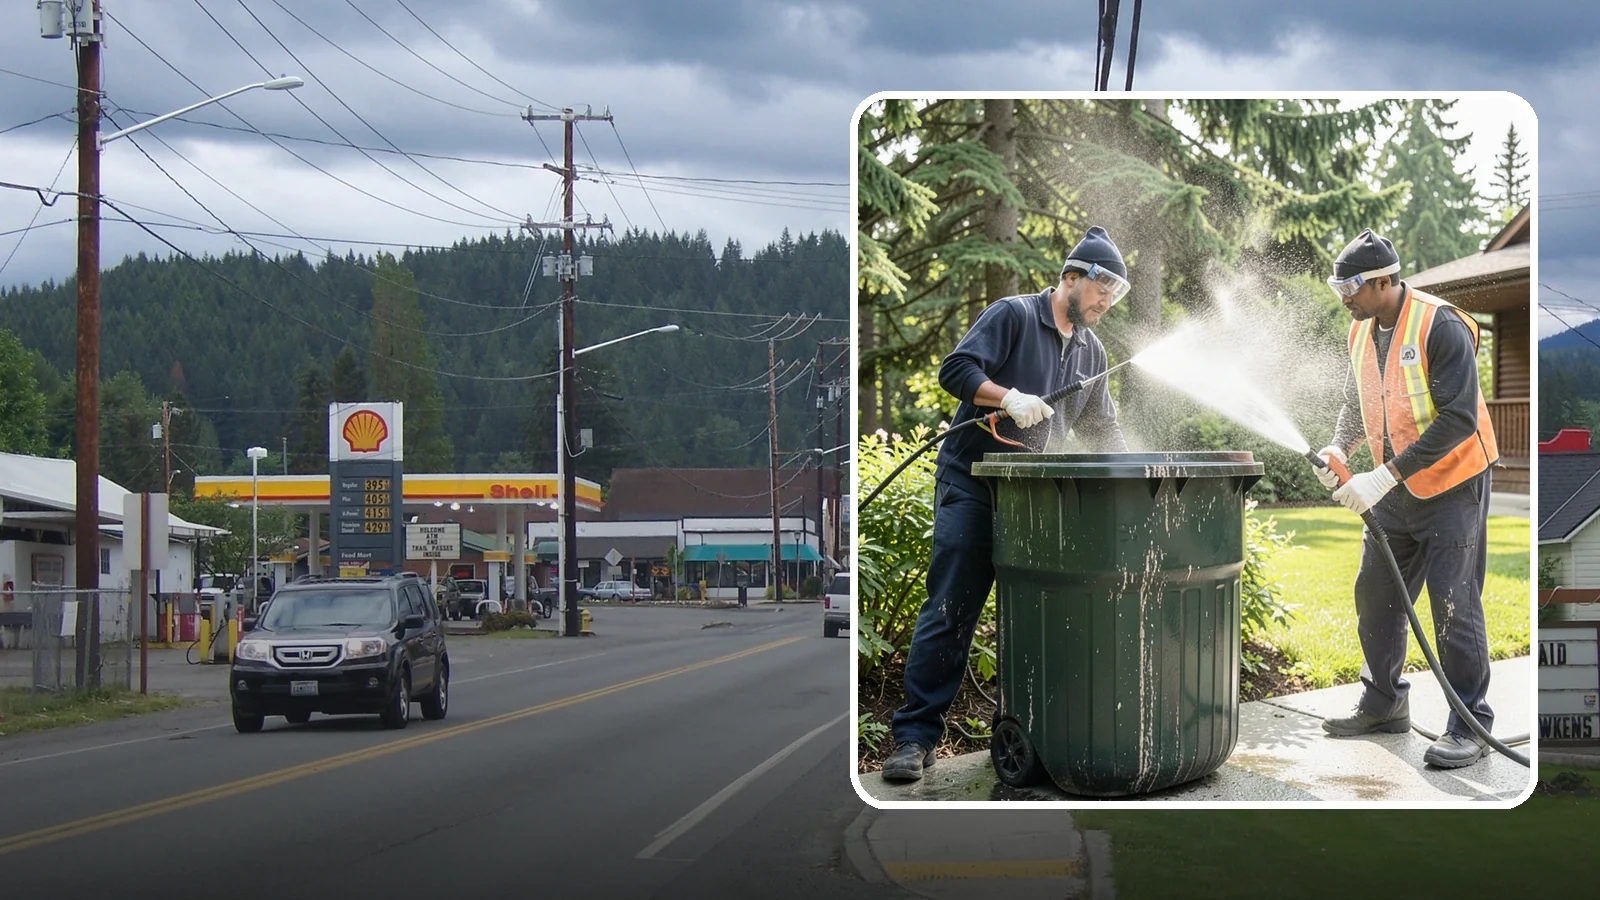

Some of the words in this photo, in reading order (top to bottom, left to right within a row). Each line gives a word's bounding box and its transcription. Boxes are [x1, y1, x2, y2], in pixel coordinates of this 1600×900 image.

[490, 484, 547, 499] Shell
[1539, 643, 1567, 665] AID
[1539, 715, 1592, 738] WKENS
